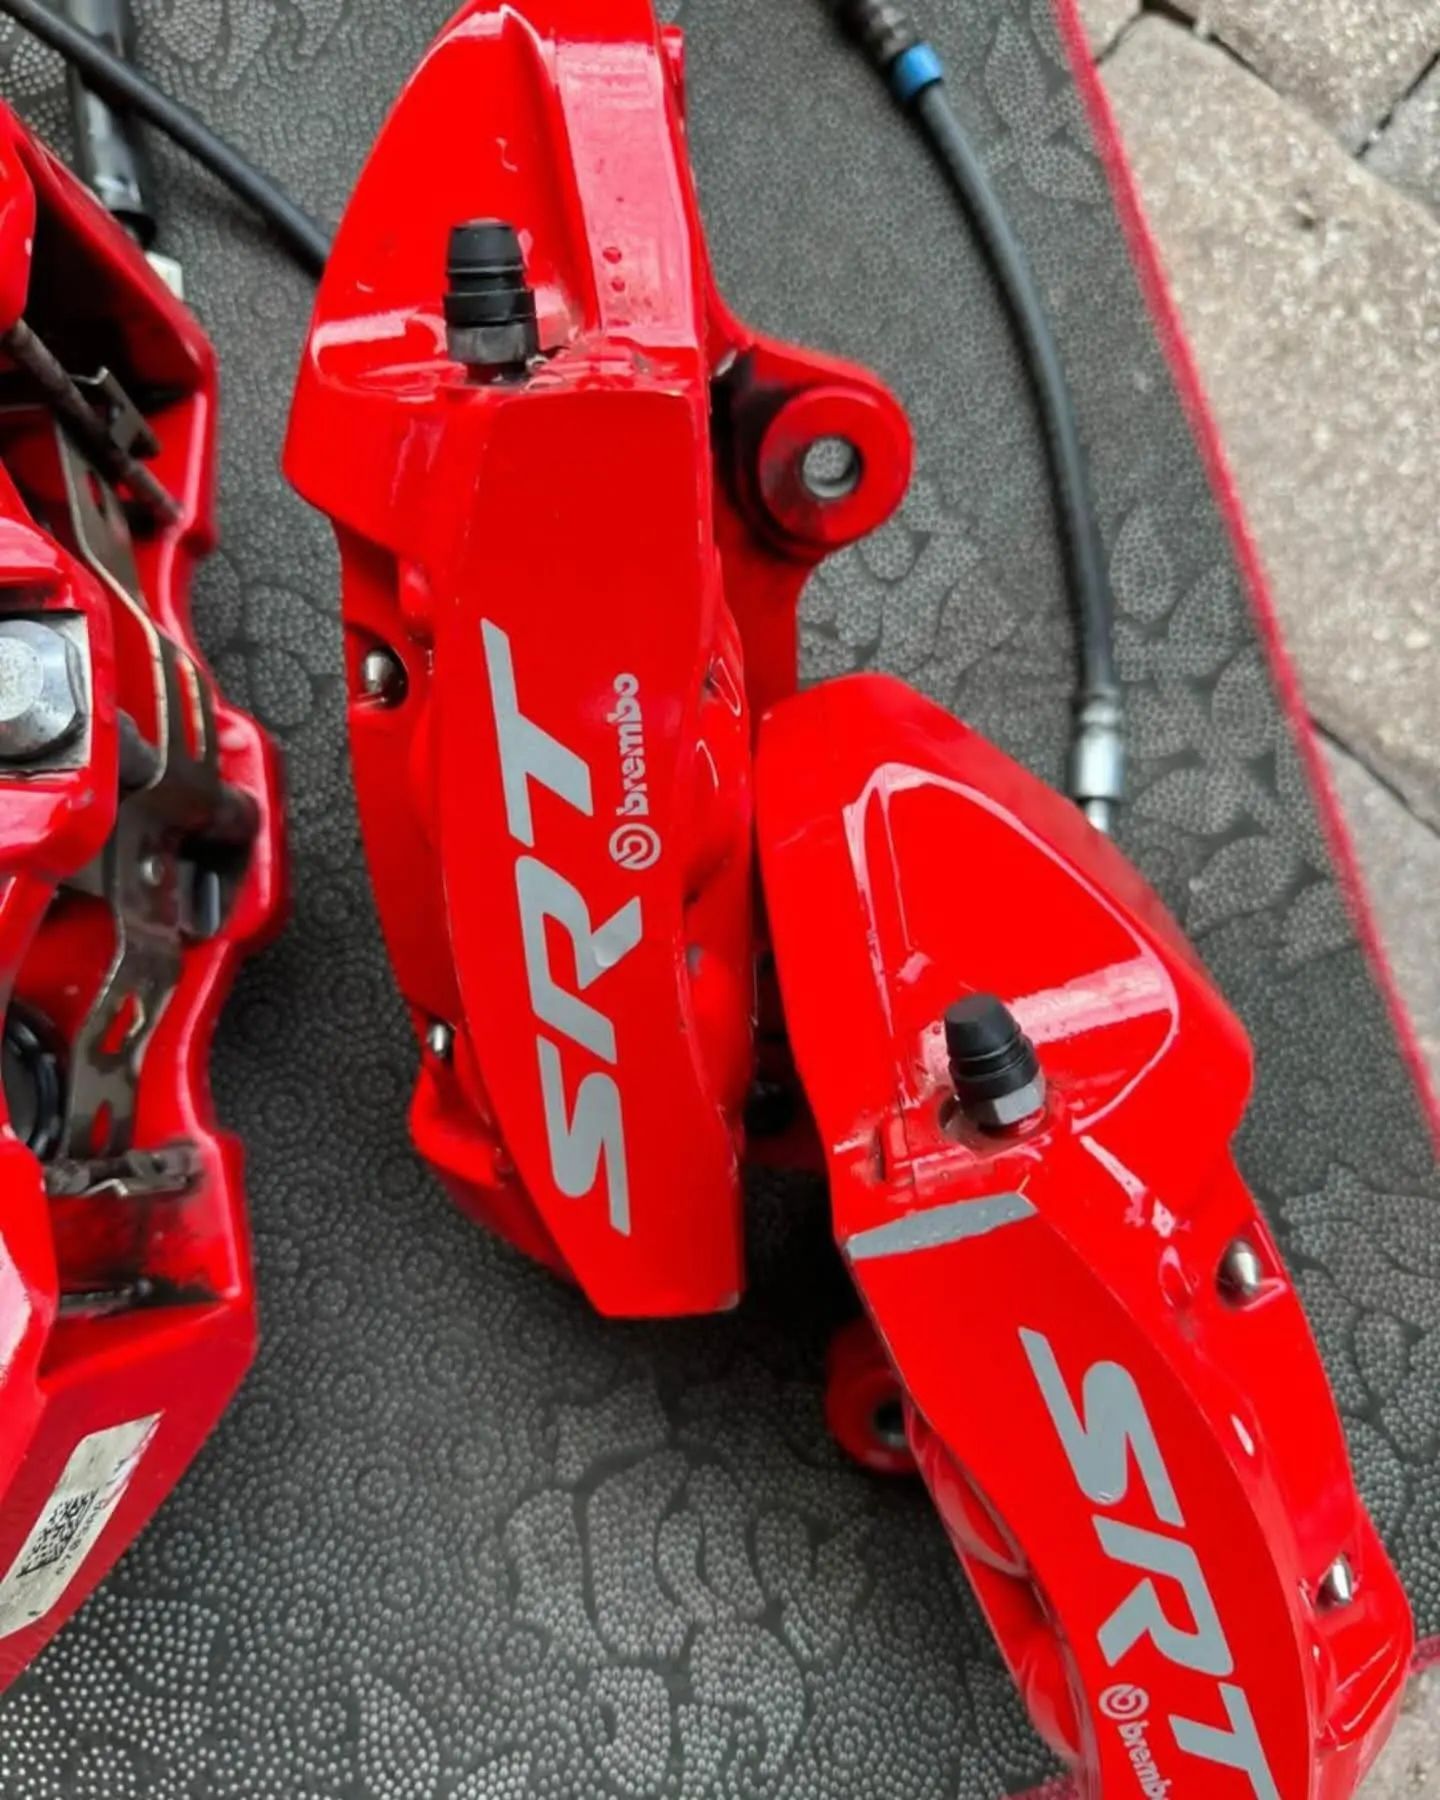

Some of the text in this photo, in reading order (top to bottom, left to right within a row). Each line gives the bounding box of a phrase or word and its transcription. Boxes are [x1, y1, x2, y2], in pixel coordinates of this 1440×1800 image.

[606, 673, 649, 816] brembo
[480, 618, 643, 1236] SRT
[1018, 1327, 1282, 1800] SRT
[1116, 1719, 1172, 1800] bremb
